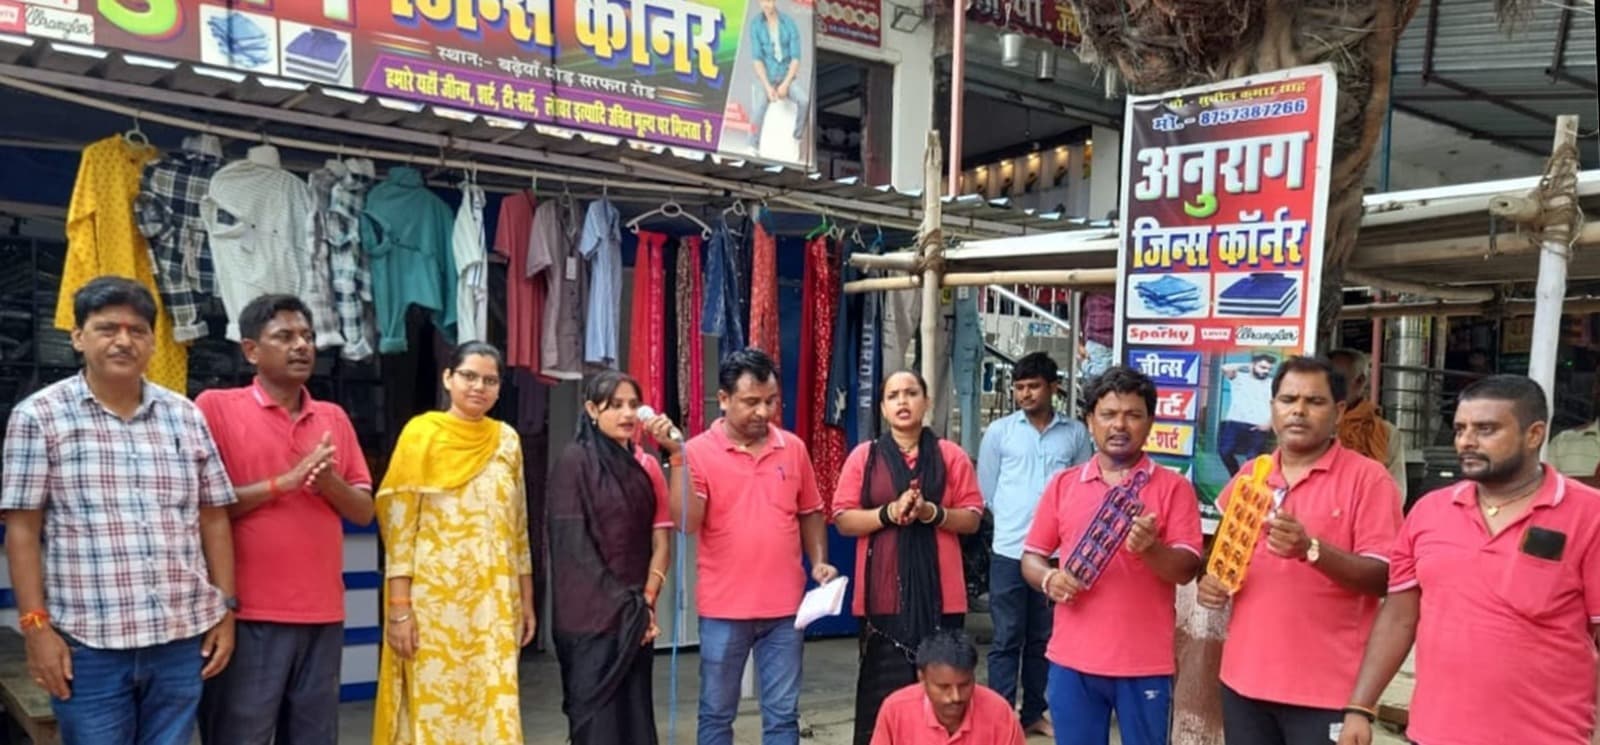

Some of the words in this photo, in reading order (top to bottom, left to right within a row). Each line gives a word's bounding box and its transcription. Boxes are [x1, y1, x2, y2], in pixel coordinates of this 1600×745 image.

[1135, 132, 1310, 217] अनुराग
[1132, 216, 1214, 270] जिन्स
[1216, 206, 1309, 268] कॉर्नर
[1129, 326, 1190, 343] Sparky
[1236, 326, 1298, 345] Wrangler
[1135, 354, 1185, 377] जीन्स
